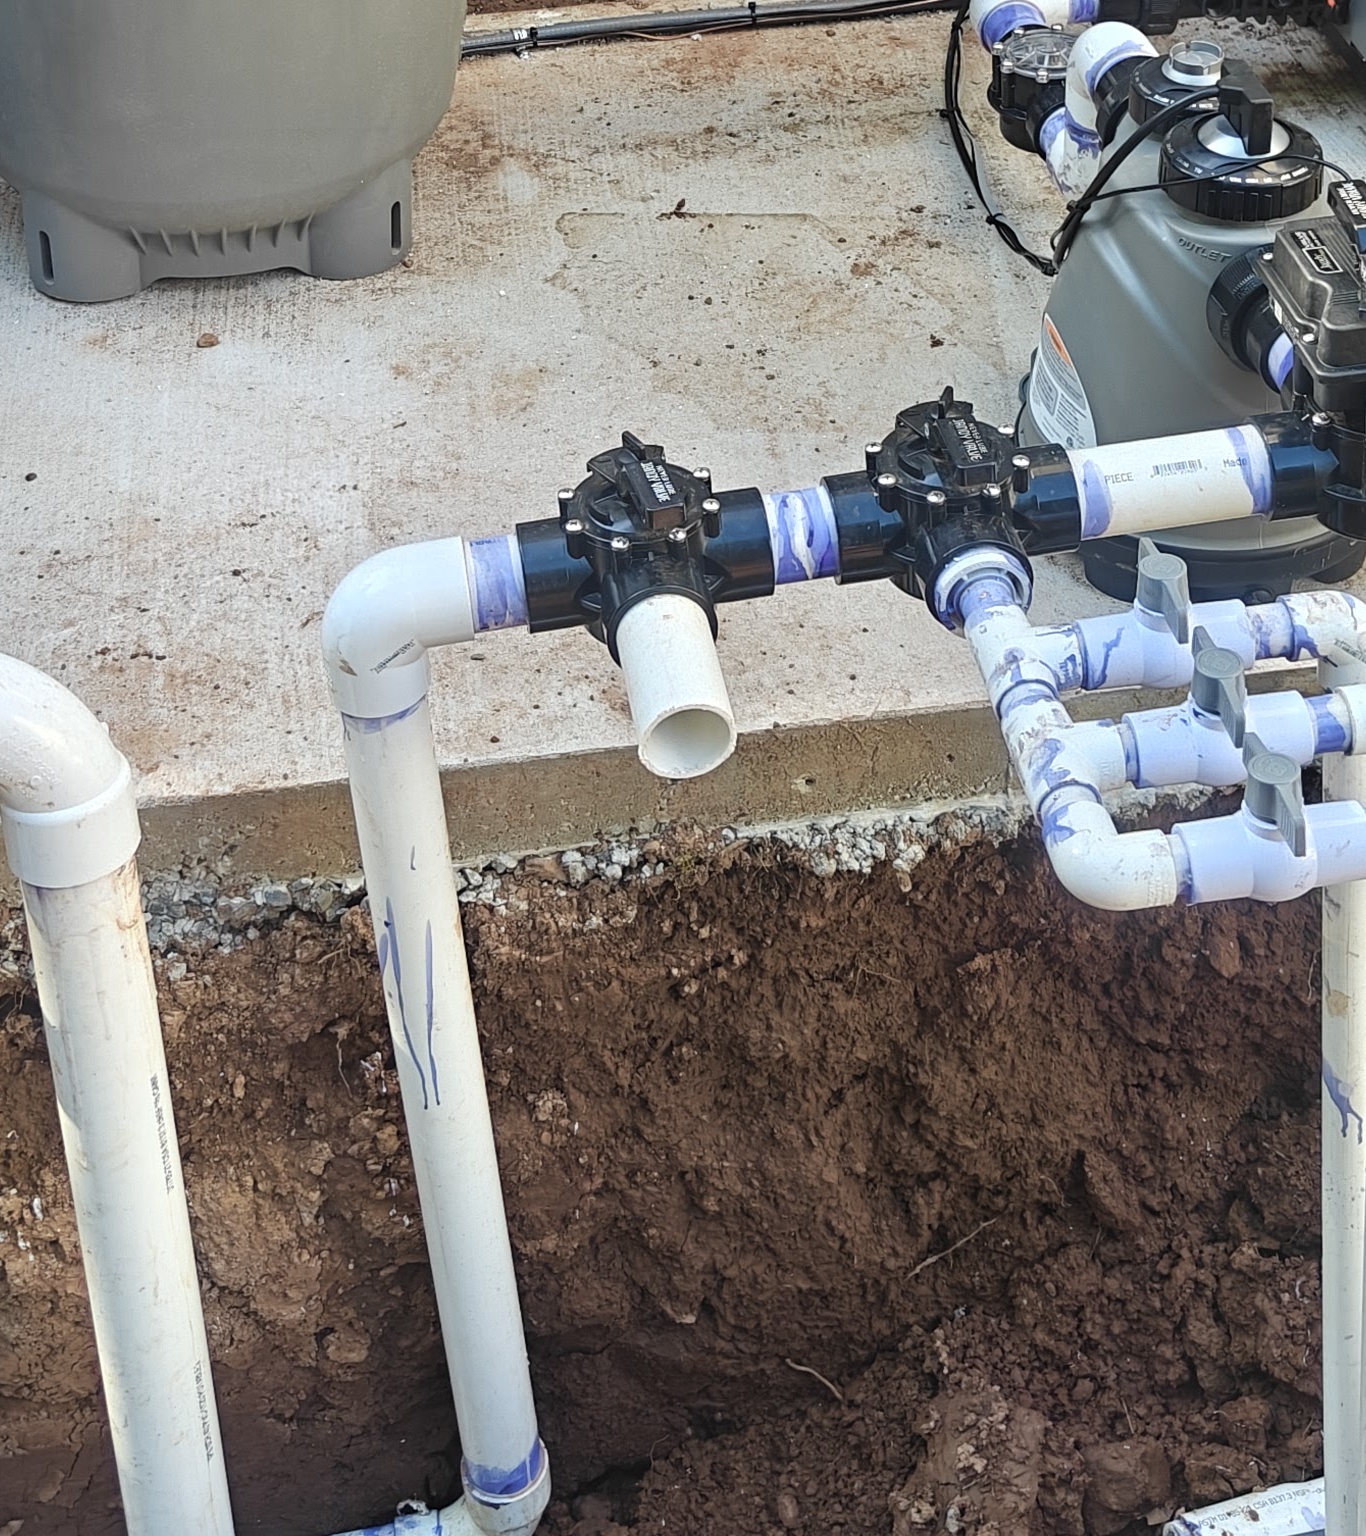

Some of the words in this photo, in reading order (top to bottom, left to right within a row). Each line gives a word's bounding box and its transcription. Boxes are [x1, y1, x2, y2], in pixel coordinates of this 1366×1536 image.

[1178, 236, 1233, 263] OUTLET
[952, 419, 973, 439] JANDY
[963, 439, 983, 462] VALVE
[968, 422, 982, 440] NEVER
[976, 439, 988, 453] LUBE
[640, 461, 662, 482] JANDY
[1223, 457, 1247, 468] Made
[1104, 472, 1134, 484] PIECE
[650, 482, 671, 503] VALVE
[1252, 1501, 1268, 1511] CSA
